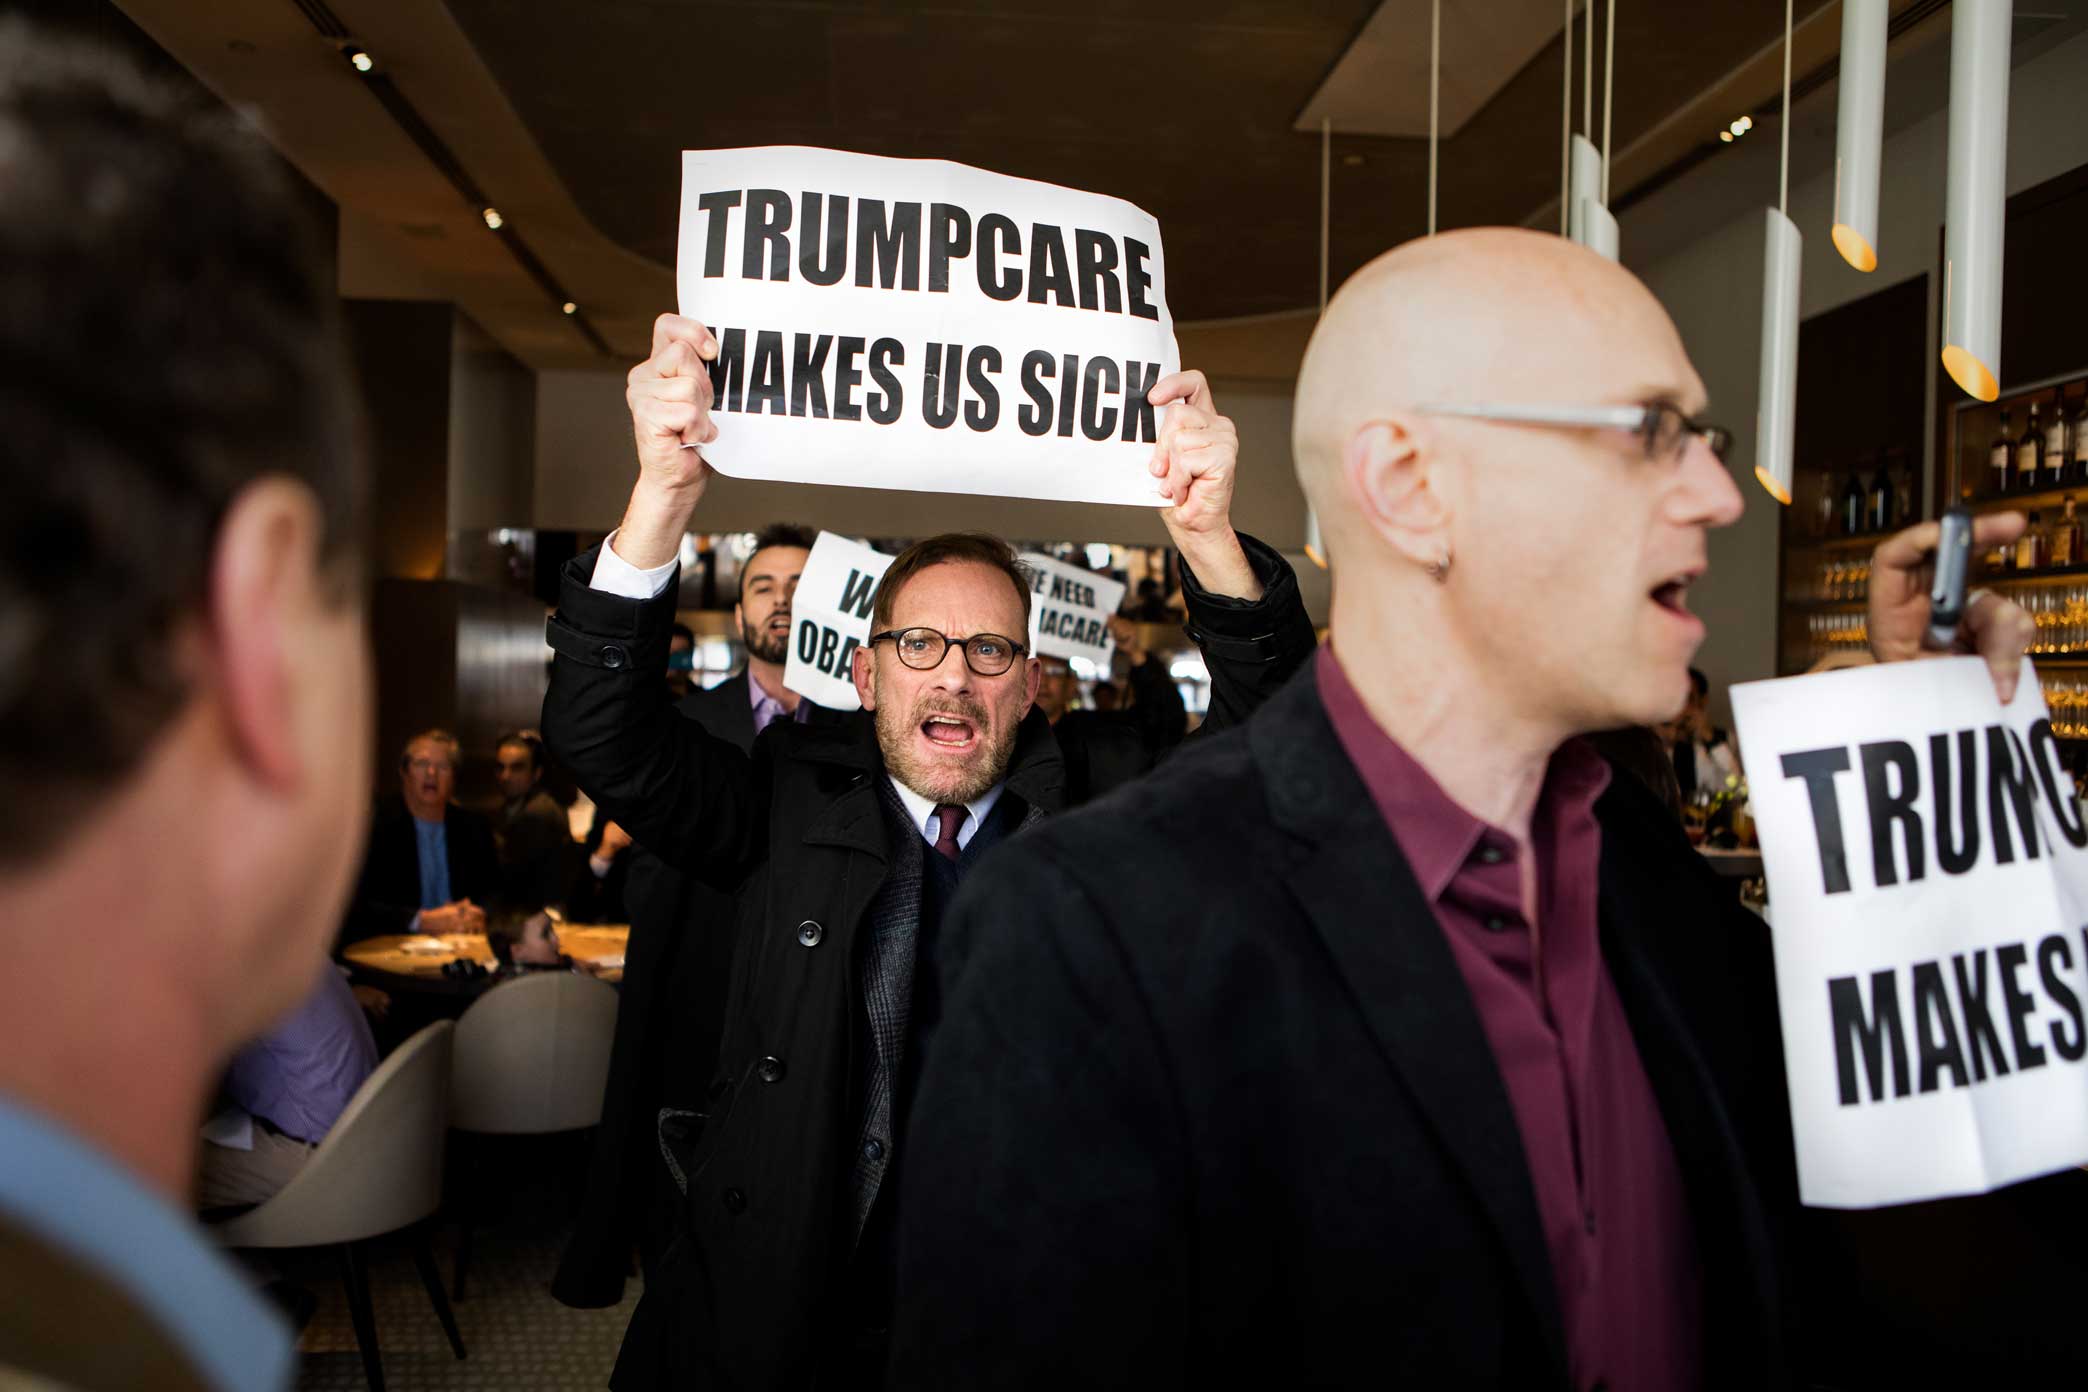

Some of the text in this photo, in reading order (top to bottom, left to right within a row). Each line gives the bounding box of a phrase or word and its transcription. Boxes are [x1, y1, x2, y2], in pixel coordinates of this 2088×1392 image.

[698, 188, 1159, 321] TRUMPCARE
[700, 325, 1161, 444] MAKES US SICK
[1038, 607, 1108, 649] ACARE
[1049, 573, 1096, 609] NEED
[1828, 934, 2087, 1106] MAKES
